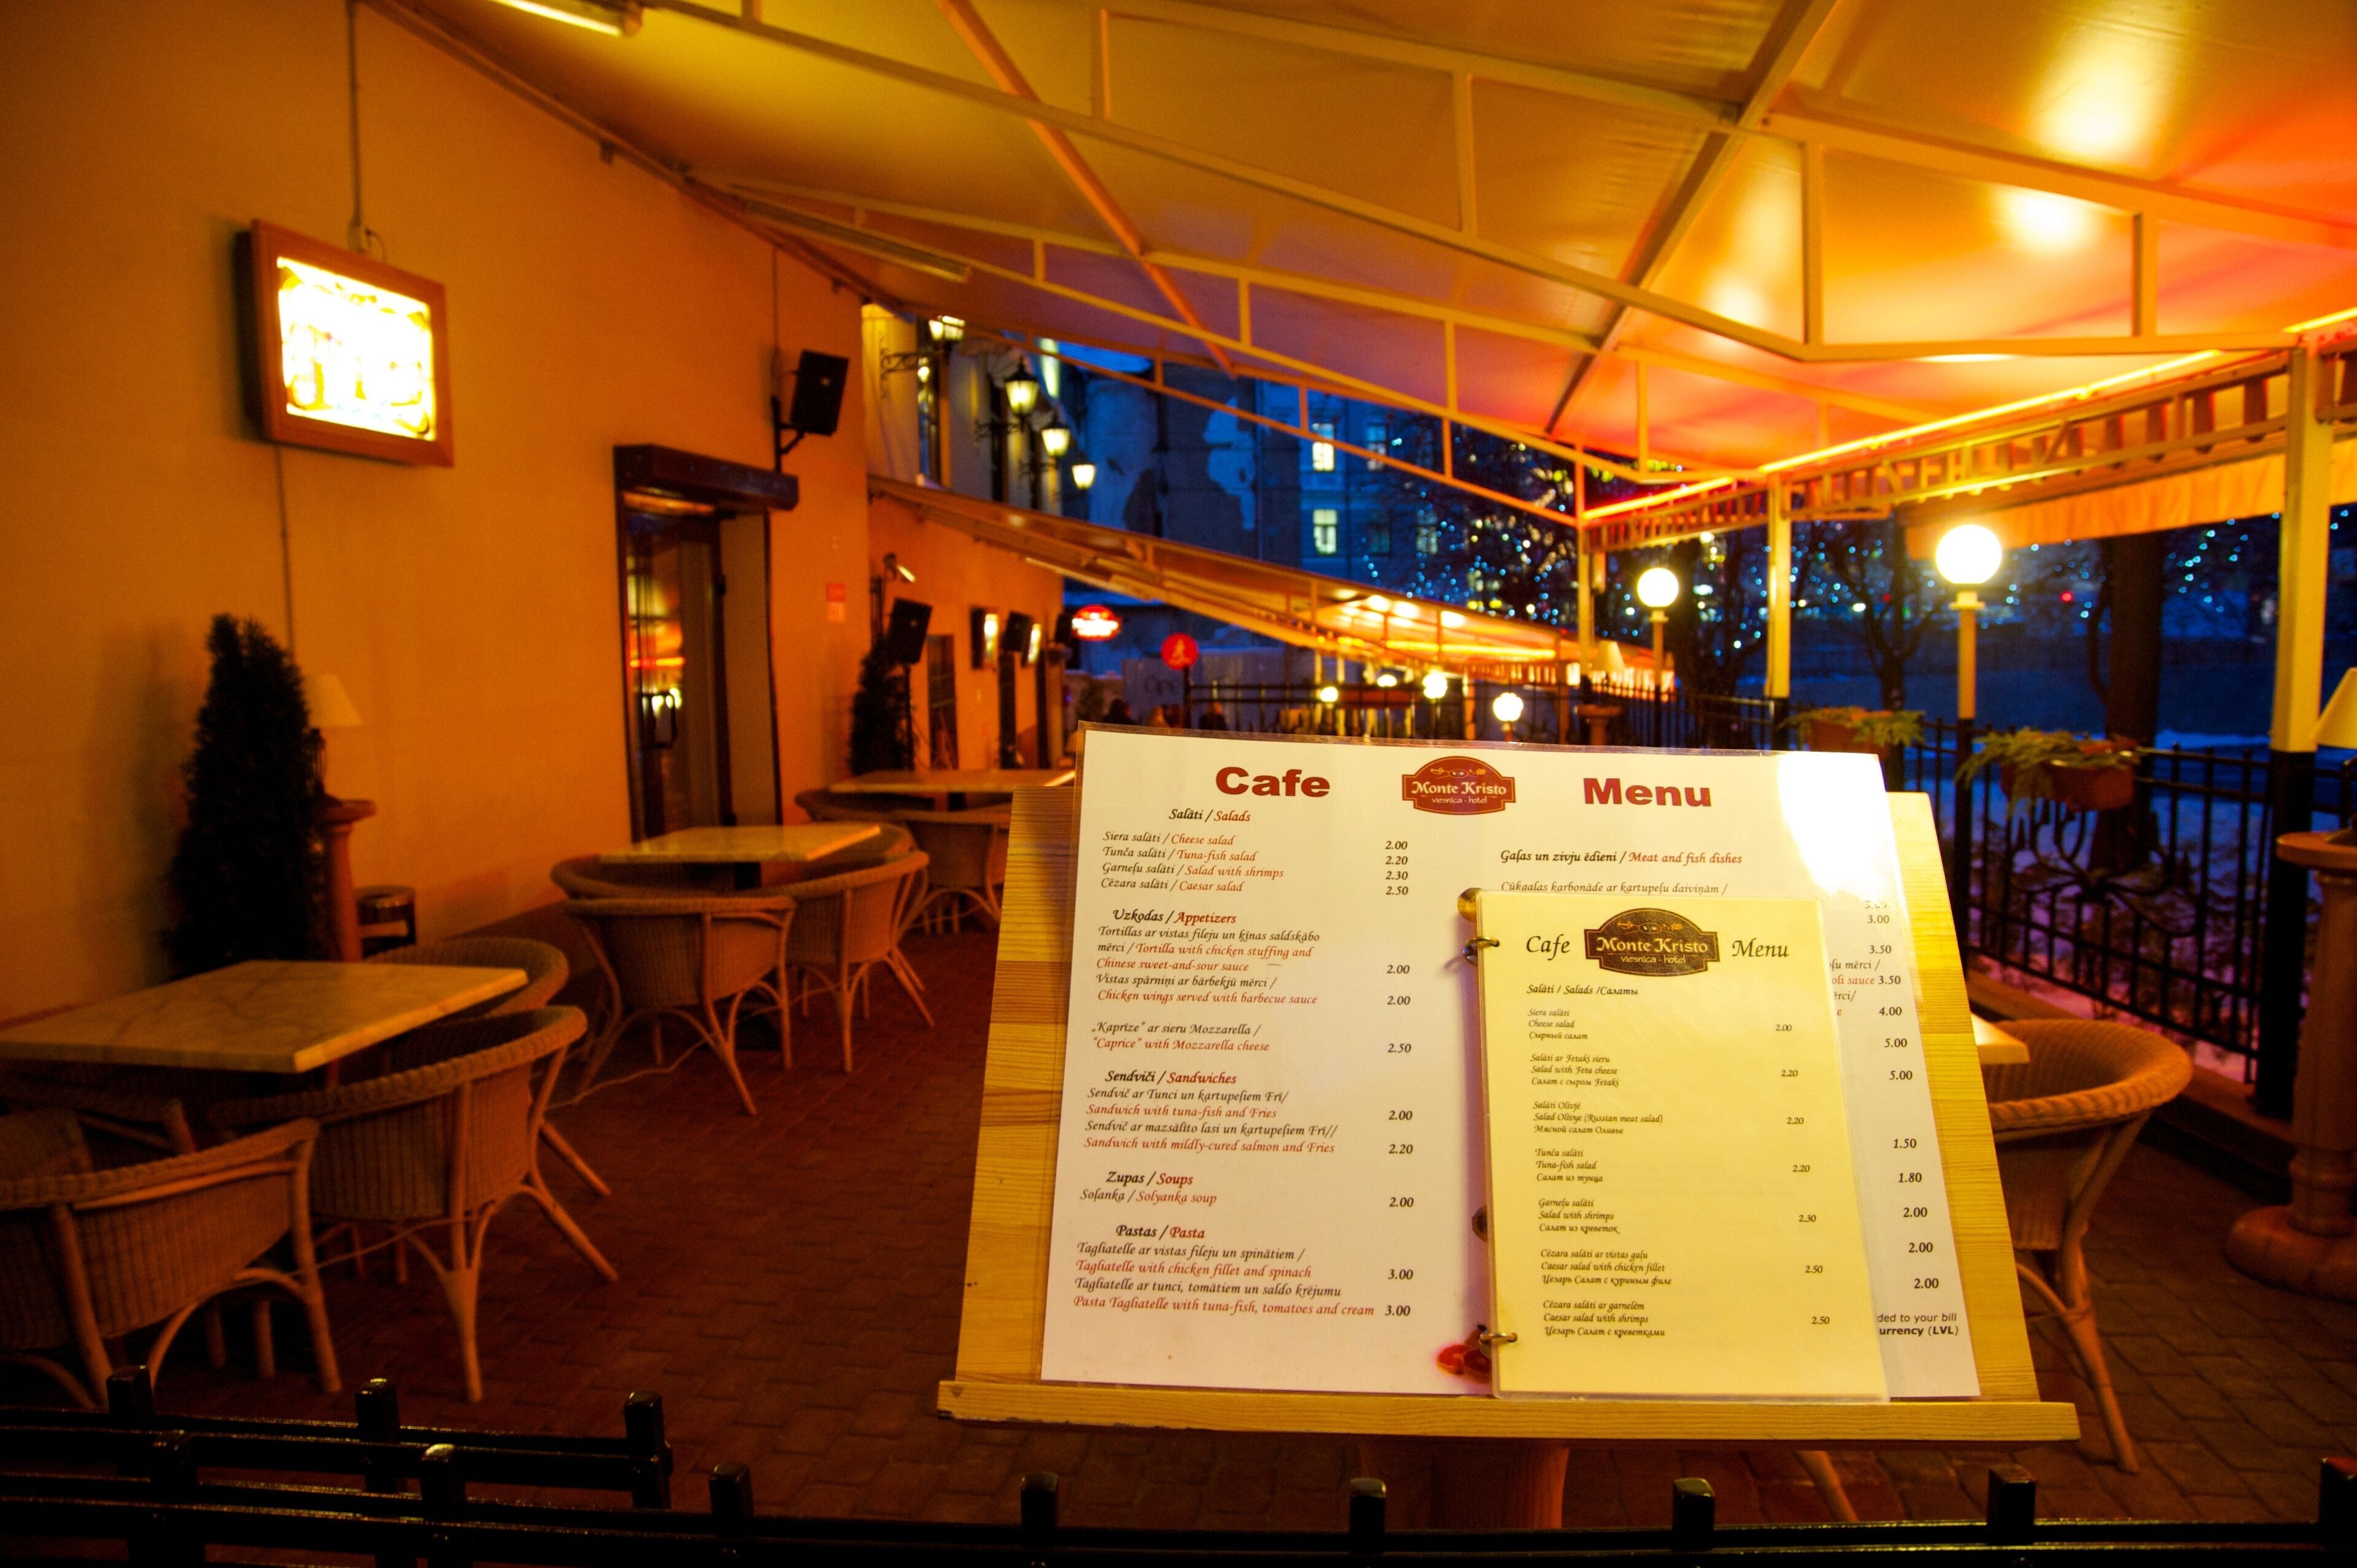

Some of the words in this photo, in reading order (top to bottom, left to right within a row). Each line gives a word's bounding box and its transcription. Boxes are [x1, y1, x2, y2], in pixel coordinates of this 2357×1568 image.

[1215, 767, 1330, 798] Cafe
[1412, 781, 1458, 794] Monte
[1461, 782, 1507, 795] Kristo
[1583, 778, 1711, 807] Menu
[1213, 810, 1251, 822] Salads
[1103, 832, 1129, 841] Siera
[1171, 833, 1204, 844] Cheese
[1207, 835, 1236, 845] salad
[1385, 841, 1407, 850] 2.00
[1177, 850, 1226, 863] Tuna-fish
[1229, 851, 1258, 861] salad
[1385, 855, 1408, 865] 2.20
[1552, 851, 1581, 865] zivju
[1629, 852, 1658, 862] Meat
[1662, 852, 1684, 862] and
[1683, 852, 1705, 866] fish
[1709, 852, 1742, 863] dishes
[1185, 865, 1216, 875] Salad
[1218, 867, 1241, 876] with
[1245, 867, 1283, 880] shrimps
[1385, 871, 1408, 880] 2.30
[1180, 881, 1213, 890] Caesar
[1216, 881, 1245, 891] salad
[1386, 886, 1409, 895] 2.50
[1113, 909, 1164, 923] Uzkodas
[1174, 912, 1236, 926] Appetizers
[1526, 934, 1569, 960] Cafe
[1596, 937, 1651, 952] Monte
[1655, 938, 1708, 953] Kristo
[1732, 938, 1789, 957] Menu
[1870, 945, 1892, 954] 3.50
[1097, 957, 1136, 968] Chinese
[1139, 960, 1218, 970] sweet-and-sour
[1663, 955, 1686, 964] hotel
[1387, 965, 1410, 974] 2.00
[1878, 975, 1901, 984] 3.50
[1563, 985, 1593, 994] Salads
[1098, 989, 1139, 1002] Chicken
[1143, 994, 1174, 1004] wings
[1177, 992, 1211, 1002] served
[1213, 992, 1237, 1002] with
[1241, 992, 1285, 1003] barbecue
[1387, 996, 1411, 1005] 2.00
[1879, 1006, 1902, 1016] 4.00
[1388, 1043, 1412, 1053] 2.50
[1884, 1038, 1907, 1048] 5.00
[1167, 1071, 1237, 1084] Sandwiches
[1889, 1070, 1913, 1080] 5.00
[1388, 1110, 1412, 1120] 2.00
[1084, 1137, 1137, 1148] Sandwich
[1142, 1138, 1167, 1148] with
[1171, 1139, 1240, 1153] mildly-cured
[1241, 1140, 1279, 1151] salmon
[1283, 1141, 1306, 1152] and
[1307, 1143, 1334, 1153] Fries
[1894, 1138, 1917, 1148] 1.50
[1388, 1144, 1413, 1154] 2.20
[1536, 1161, 1573, 1172] Tuna-fish
[1106, 1171, 1145, 1187] Zupas
[1156, 1173, 1193, 1189] Soups
[1898, 1172, 1922, 1183] 1.80
[1389, 1197, 1414, 1207] 2.00
[1584, 1211, 1614, 1222] shrimps
[1903, 1207, 1927, 1218] 2.00
[1116, 1225, 1157, 1237] Pastas
[1170, 1227, 1205, 1238] Pasta
[1908, 1242, 1933, 1253] 2.00
[1614, 1262, 1643, 1273] chicken
[1645, 1263, 1664, 1275] fillet
[1805, 1265, 1823, 1273] 2.50
[1388, 1269, 1414, 1280] 3.00
[1914, 1278, 1939, 1289] 2.00
[1074, 1296, 1105, 1307] Pasta
[1110, 1297, 1168, 1311] Tagliatelle
[1172, 1299, 1198, 1310] with
[1203, 1300, 1257, 1315] tuna-fish,
[1263, 1304, 1313, 1313] tomatoes
[1317, 1303, 1340, 1314] and
[1385, 1305, 1411, 1316] 3.00
[1573, 1313, 1594, 1322] salad
[1596, 1313, 1615, 1322] with
[1618, 1314, 1648, 1326] shrimps
[1914, 1315, 1938, 1324] your
[1928, 1326, 1958, 1336] (LVL)
